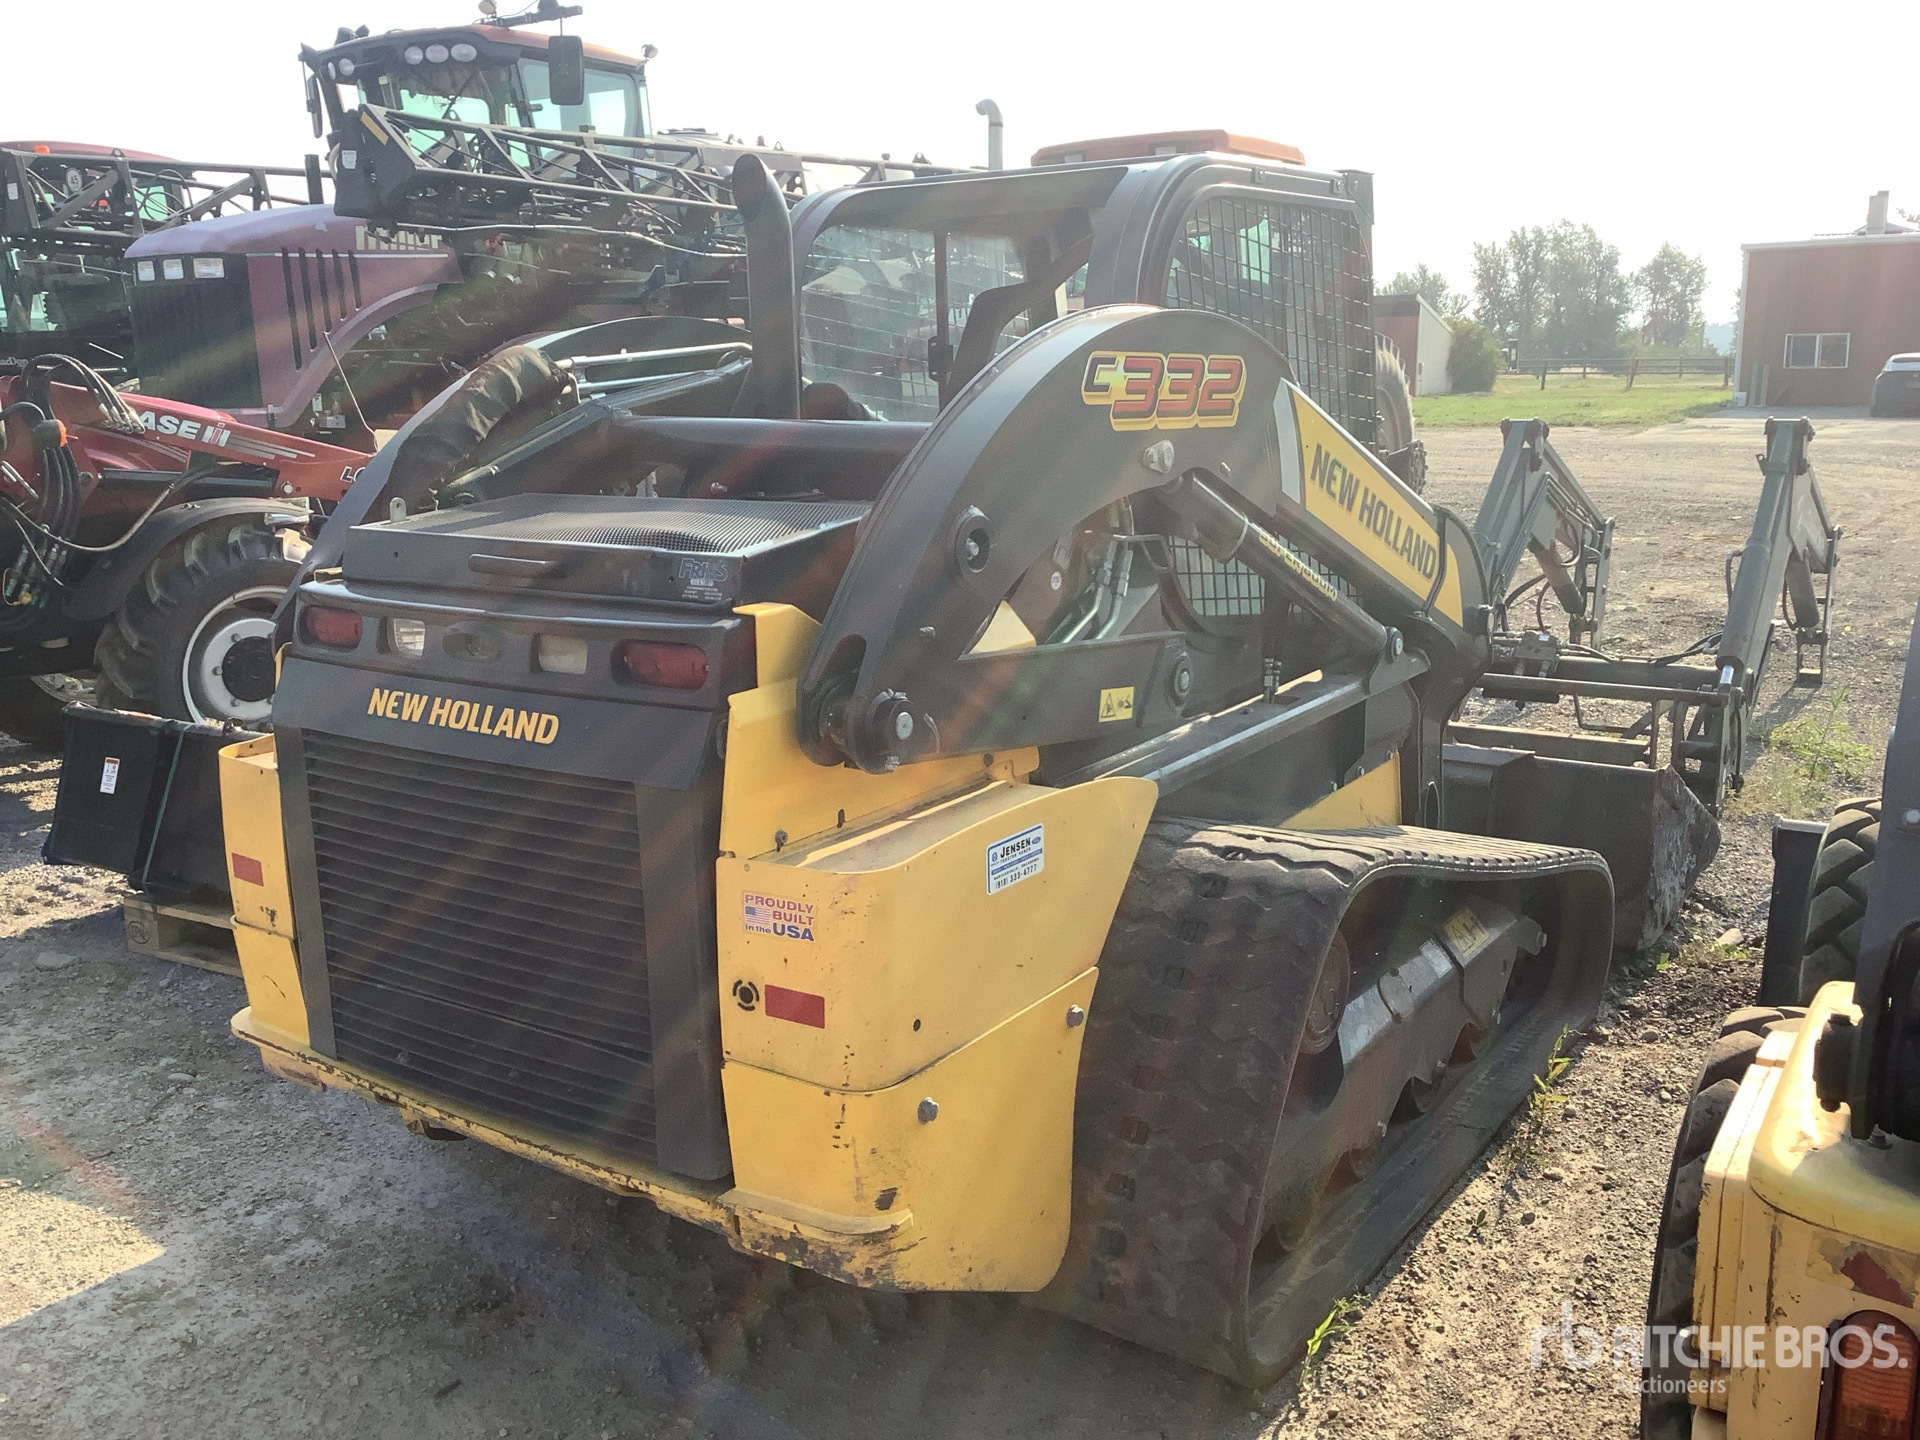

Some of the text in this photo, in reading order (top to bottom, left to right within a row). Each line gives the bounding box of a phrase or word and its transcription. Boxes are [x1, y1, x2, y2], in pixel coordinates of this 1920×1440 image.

[140, 410, 201, 440] ASE
[1310, 442, 1437, 580] NEW HOLLAND
[367, 687, 560, 745] NEW HOLLAND
[1000, 836, 1031, 858] JENSEN
[745, 894, 814, 914] PROUDLY
[772, 910, 815, 926] BUILT
[745, 922, 815, 942] in the USA
